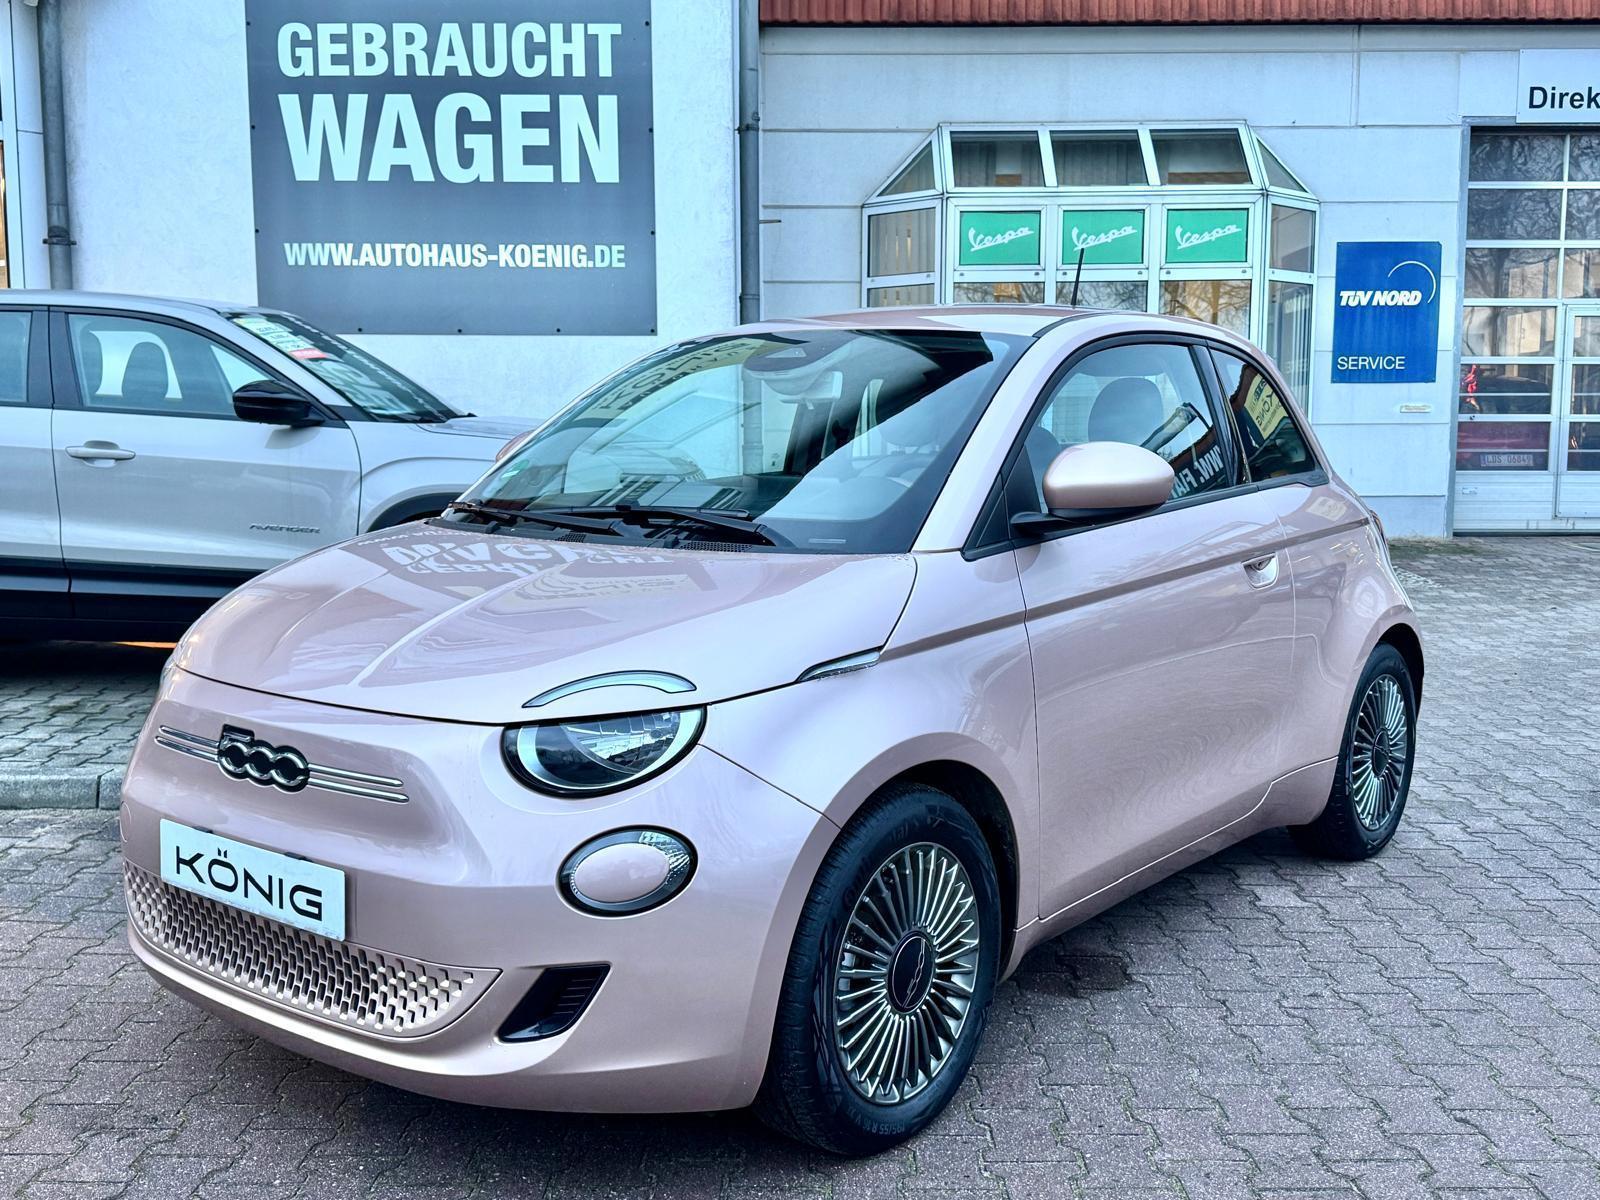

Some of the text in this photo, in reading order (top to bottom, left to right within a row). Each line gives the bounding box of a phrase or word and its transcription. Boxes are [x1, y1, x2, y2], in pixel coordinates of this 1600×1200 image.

[277, 22, 622, 78] GEBRAUCHT
[1528, 86, 1600, 109] Direk
[278, 92, 620, 184] WAGEN
[968, 226, 1034, 253] Vespa
[1071, 225, 1138, 252] Vespa
[1175, 224, 1242, 250] Vespa
[284, 242, 626, 269] WWW.AUTOHAUS-KOENIG.DE
[1339, 290, 1422, 307] TÜV NORD
[1337, 356, 1405, 370] SERVICE
[175, 845, 323, 922] KÖNIG
